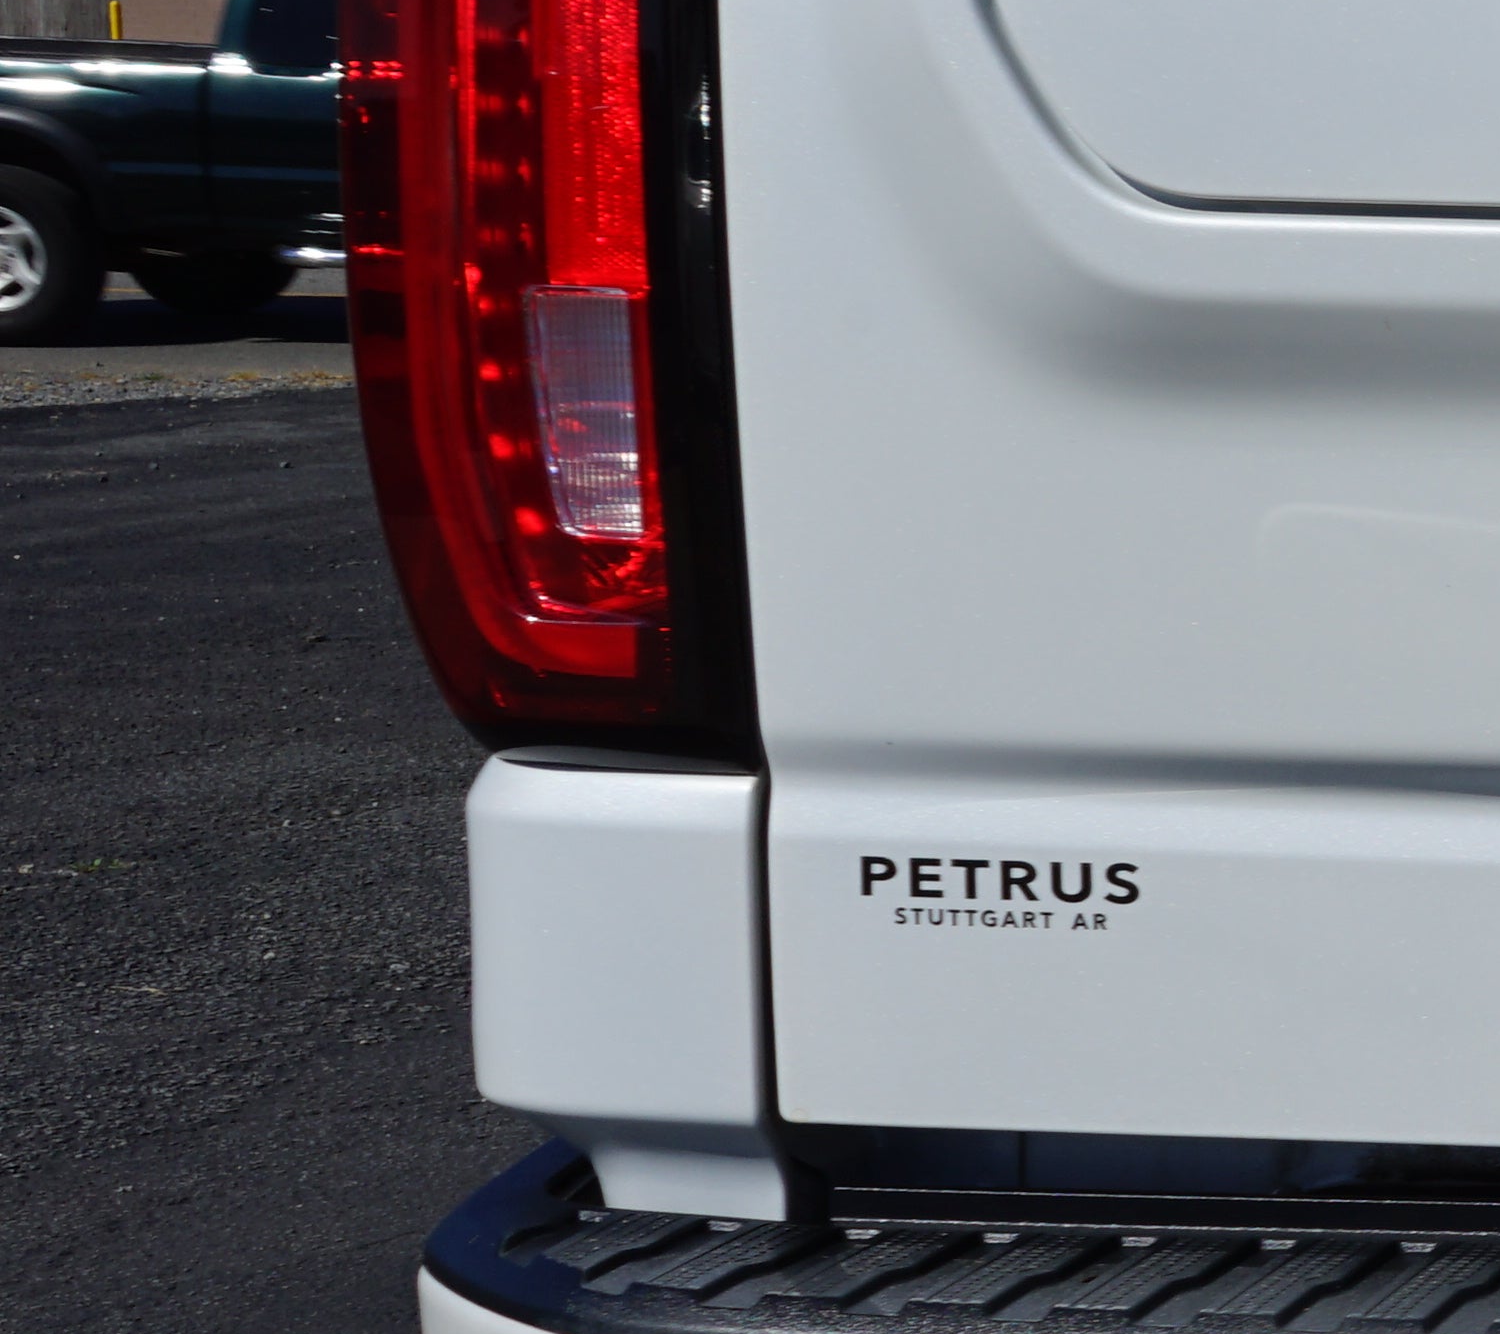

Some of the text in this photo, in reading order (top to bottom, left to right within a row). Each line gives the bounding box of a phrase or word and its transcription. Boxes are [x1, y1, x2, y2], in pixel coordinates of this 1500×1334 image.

[860, 855, 1140, 905] PETRUS
[894, 907, 1109, 931] STUTTGART AR
